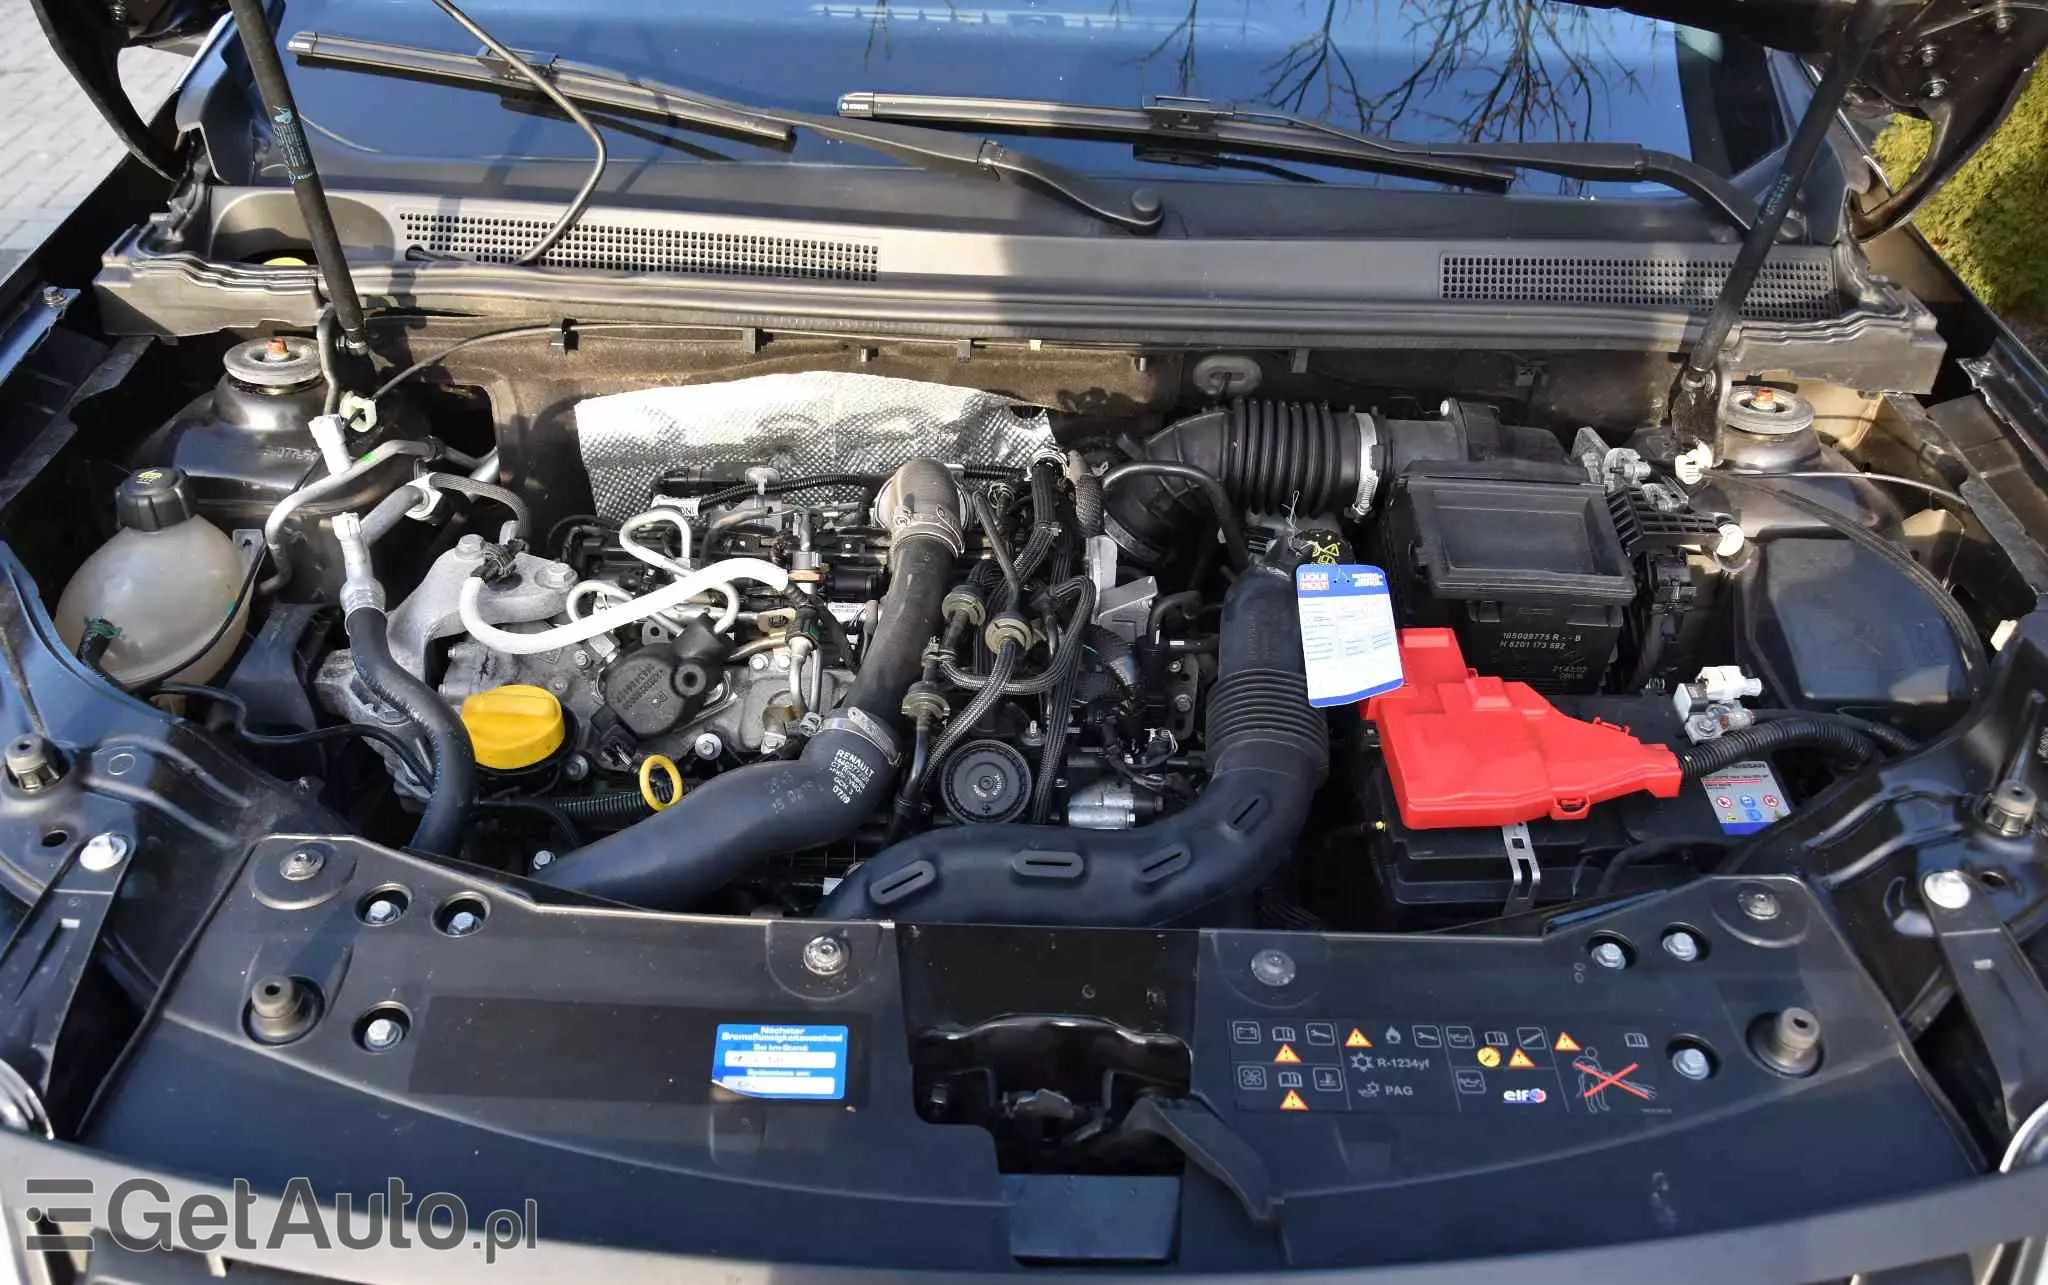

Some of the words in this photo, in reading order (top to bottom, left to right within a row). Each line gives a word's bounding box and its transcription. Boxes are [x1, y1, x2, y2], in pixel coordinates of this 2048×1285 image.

[836, 749, 875, 777] RENAULT
[1377, 1058, 1430, 1071] R-1234yf
[1385, 1085, 1413, 1096] PAG
[1503, 1089, 1529, 1101] elf
